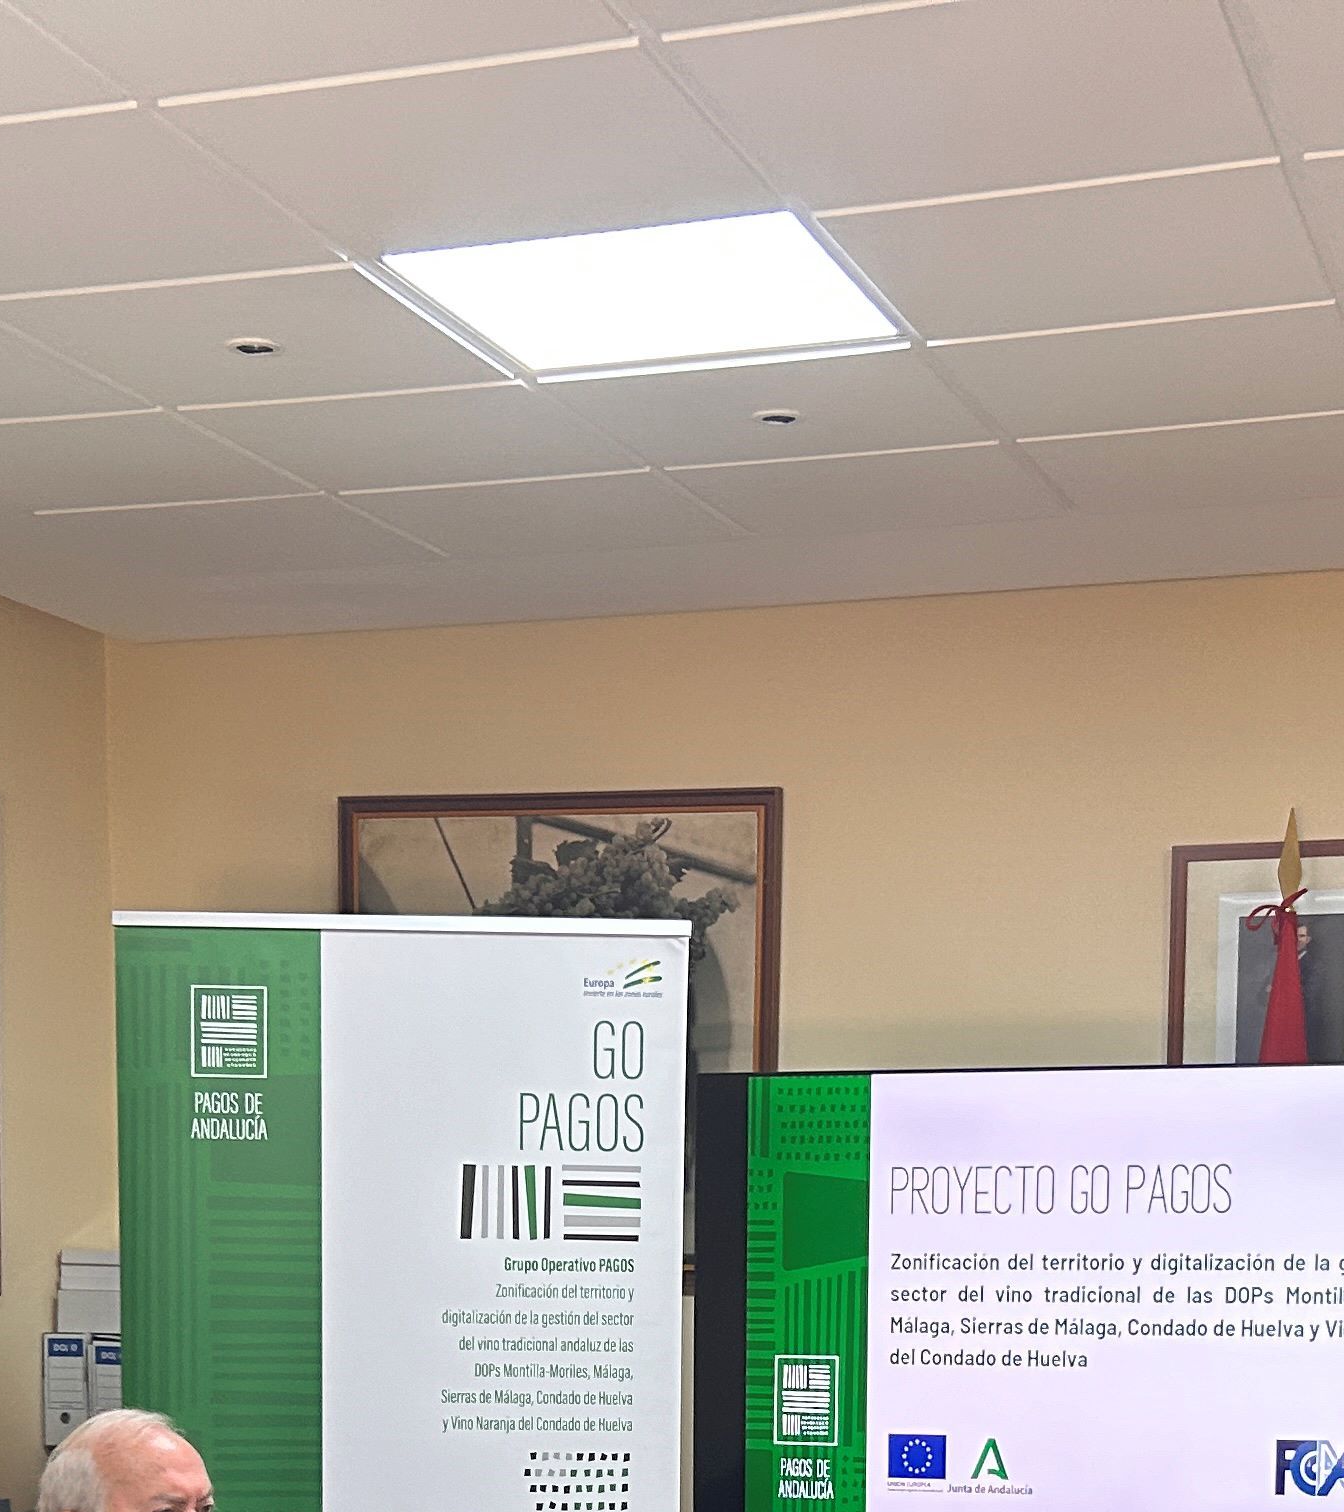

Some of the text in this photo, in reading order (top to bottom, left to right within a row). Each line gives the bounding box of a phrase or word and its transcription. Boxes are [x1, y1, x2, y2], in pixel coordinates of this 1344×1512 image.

[583, 978, 615, 990] Europa
[593, 1020, 644, 1080] GO
[194, 1091, 264, 1115] PAGOS DE
[191, 1114, 268, 1140] ANDALUCÍA
[520, 1093, 644, 1152] PAGOS
[891, 1163, 1232, 1215] PROYECTO GO PAGOS
[504, 1257, 635, 1274] Grupo Operativo PAGOS
[890, 1253, 1000, 1271] Zonificación
[1007, 1253, 1034, 1271] del
[1042, 1253, 1124, 1271] territorio
[1133, 1257, 1143, 1275] y
[1151, 1253, 1275, 1275] digitalización
[1284, 1254, 1306, 1271] de
[1315, 1254, 1330, 1271] la
[495, 1283, 635, 1302] Zonificación del territorio y
[890, 1287, 947, 1302] sector
[958, 1285, 984, 1303] del
[996, 1285, 1032, 1303] vino
[1045, 1285, 1141, 1303] tradicional
[1153, 1286, 1175, 1303] de
[1187, 1287, 1213, 1303] las
[1225, 1287, 1274, 1304] DOPs
[442, 1309, 634, 1328] digitalización de la gestión del sector
[890, 1316, 954, 1338] Málaga,
[960, 1317, 1023, 1335] Sierras
[1028, 1318, 1049, 1335] de
[1055, 1317, 1122, 1339] Málaga,
[1128, 1319, 1207, 1336] Condado
[1213, 1319, 1235, 1337] de
[1241, 1319, 1304, 1338] Huelva
[1309, 1324, 1320, 1342] y
[459, 1336, 634, 1353] del vino tradicional andaluz de las
[890, 1349, 1088, 1367] del Condado de Huelva
[474, 1363, 634, 1382] DOPs Montilla-Moriles, Málaga,
[441, 1389, 633, 1407] Sierras de Málaga, Condado de Huelva
[442, 1416, 633, 1434] y Vino Naranja del Condado de Huelva
[780, 1458, 831, 1478] PAGOS DE
[778, 1477, 835, 1500] ANDALUCÍA
[947, 1484, 973, 1494] Junta
[975, 1485, 986, 1494] de
[988, 1484, 1033, 1495] Andalucía
